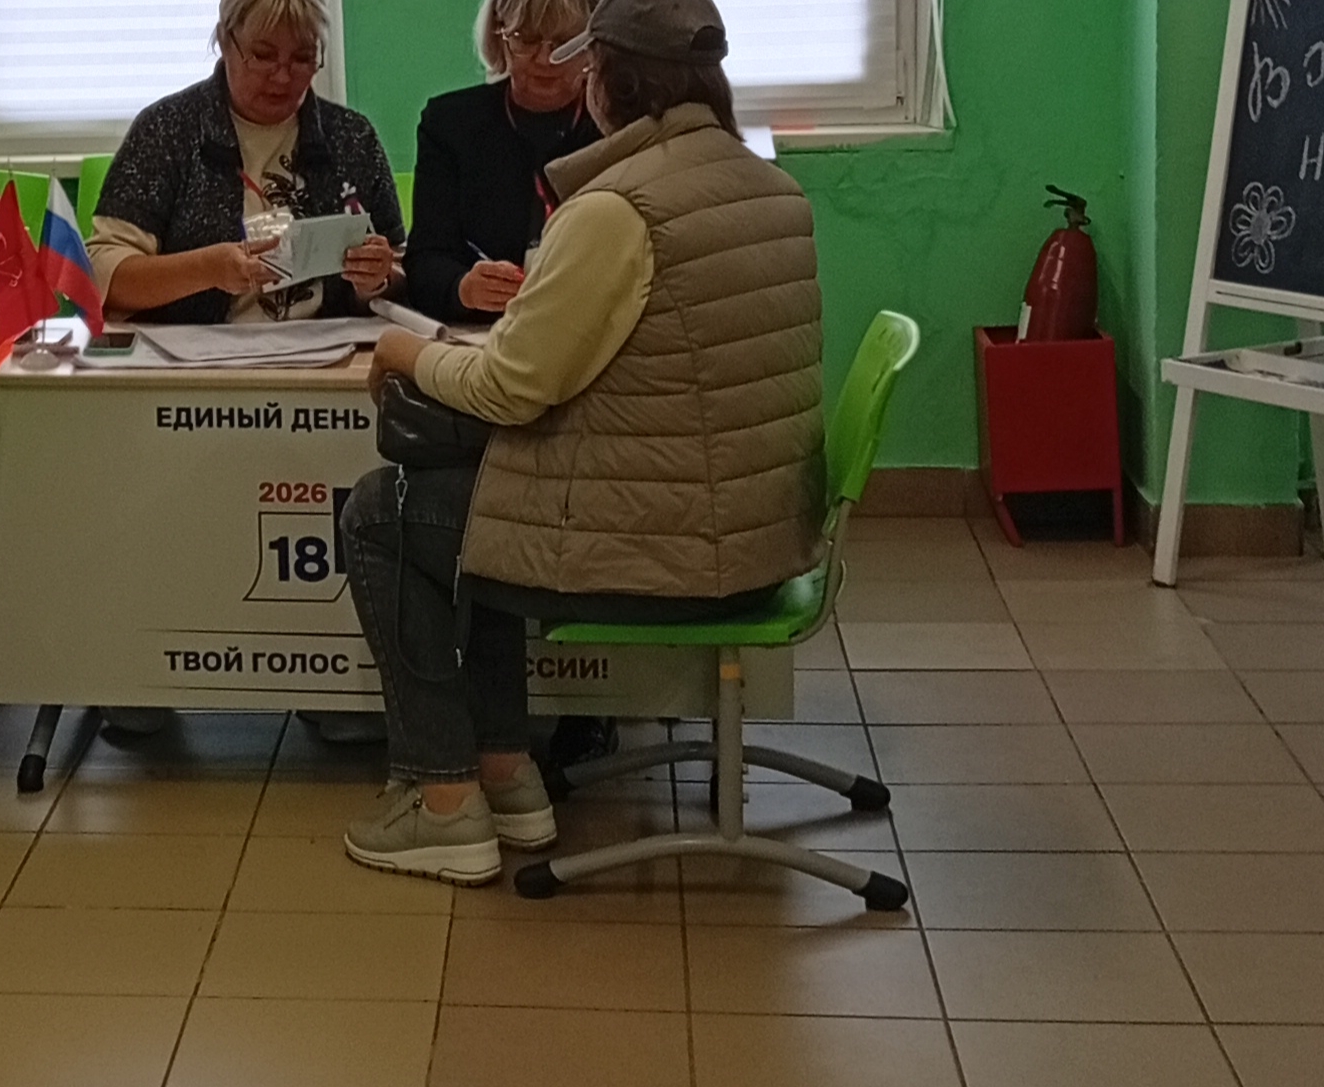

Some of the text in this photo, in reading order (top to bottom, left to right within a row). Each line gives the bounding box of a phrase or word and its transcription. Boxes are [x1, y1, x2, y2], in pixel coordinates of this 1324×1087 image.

[156, 401, 371, 433] ЕДИНЫЙ ДЕНЬ
[258, 481, 328, 504] 2026
[268, 535, 330, 583] 18
[163, 645, 243, 673] ТВОЙ
[251, 652, 350, 675] ГОЛОС
